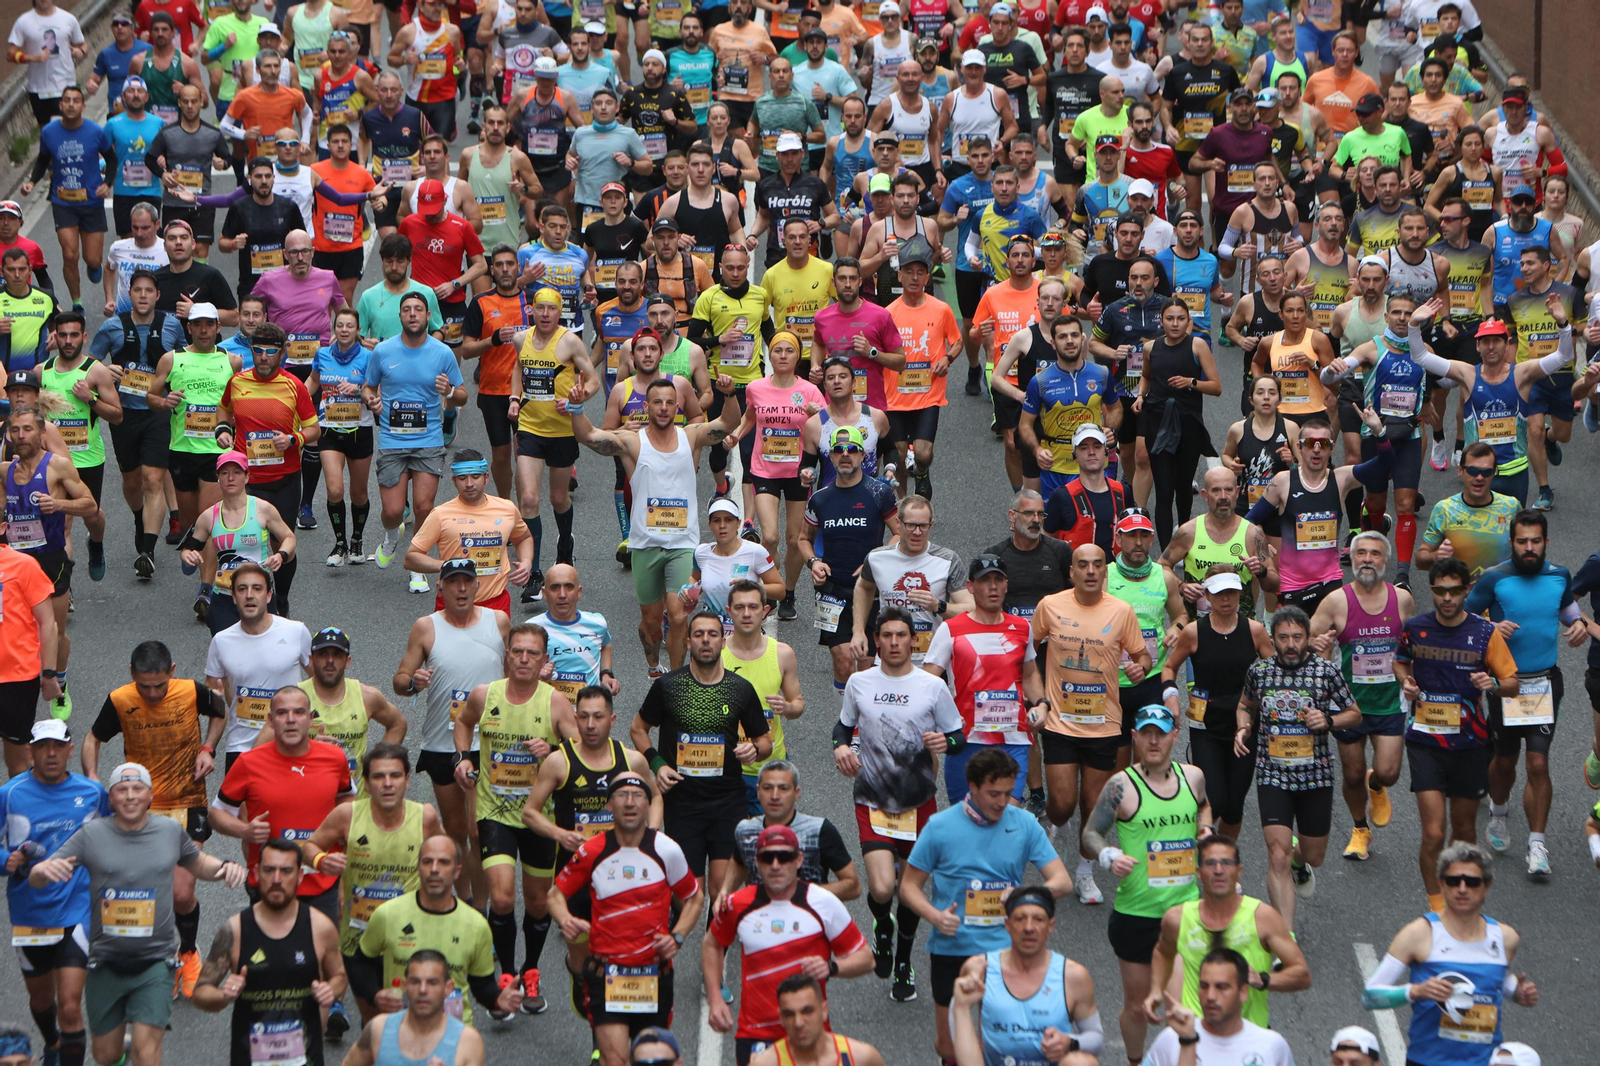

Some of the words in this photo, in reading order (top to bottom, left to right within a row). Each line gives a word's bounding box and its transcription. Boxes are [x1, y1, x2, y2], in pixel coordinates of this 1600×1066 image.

[988, 53, 1014, 64] FILA
[1185, 85, 1220, 94] ARUNCI
[768, 196, 812, 208] Heróis
[786, 304, 818, 314] SEVILLA
[1000, 324, 1022, 332] RUN!
[520, 359, 556, 368] BEDFORD
[187, 380, 216, 391] CORRE
[783, 406, 805, 415] TRAIL
[824, 517, 867, 529] FRANCE
[822, 595, 843, 605] ZURICH
[1358, 627, 1390, 636] ULISES
[1060, 634, 1081, 642] Maratón
[874, 693, 909, 704] LOBXS
[1282, 726, 1308, 735] ZURICH
[1166, 840, 1191, 850] ZURICH
[985, 881, 1011, 889] ZURICH
[119, 890, 150, 899] ZURICH
